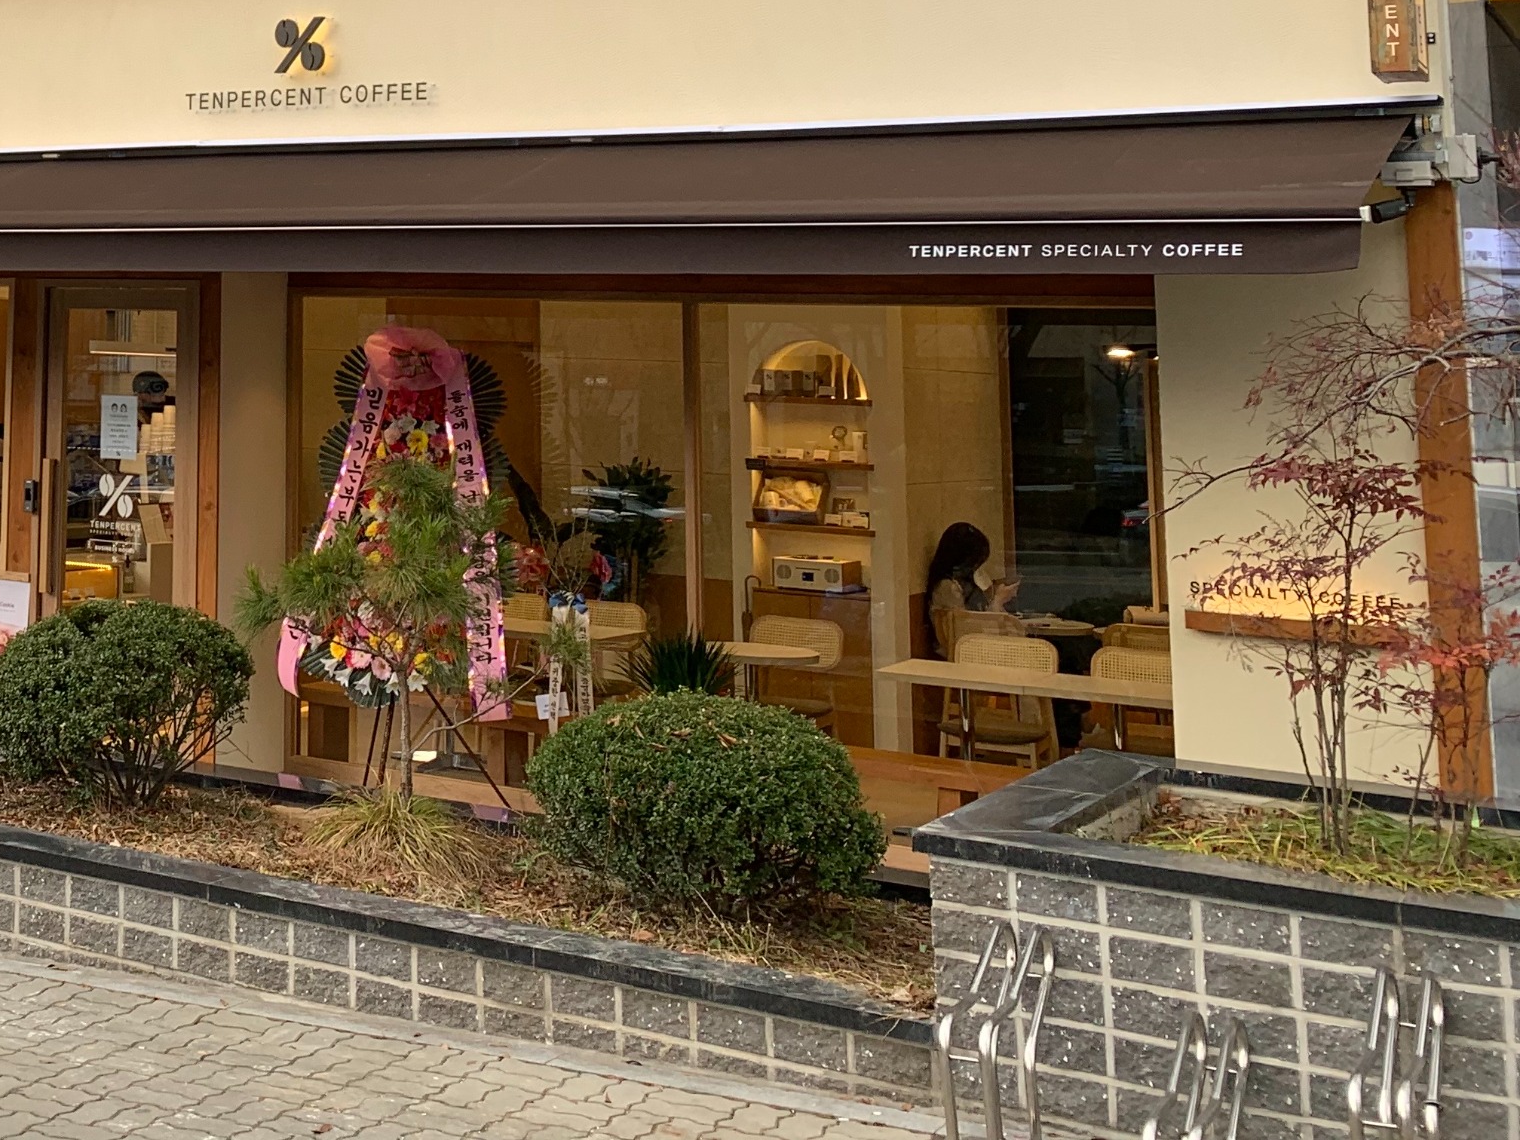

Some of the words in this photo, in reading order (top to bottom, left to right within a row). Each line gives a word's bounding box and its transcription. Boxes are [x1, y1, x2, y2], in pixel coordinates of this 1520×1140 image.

[185, 87, 327, 111] TENPERCENT
[340, 82, 428, 104] COFFEE
[910, 245, 1032, 258] TENPERCENT
[1041, 244, 1153, 257] SPECIALTY
[1162, 244, 1244, 257] COFFEE
[90, 520, 141, 532] TENPERCENT
[1190, 581, 1307, 602] SPECIALTY
[1319, 591, 1401, 609] COFFEE
